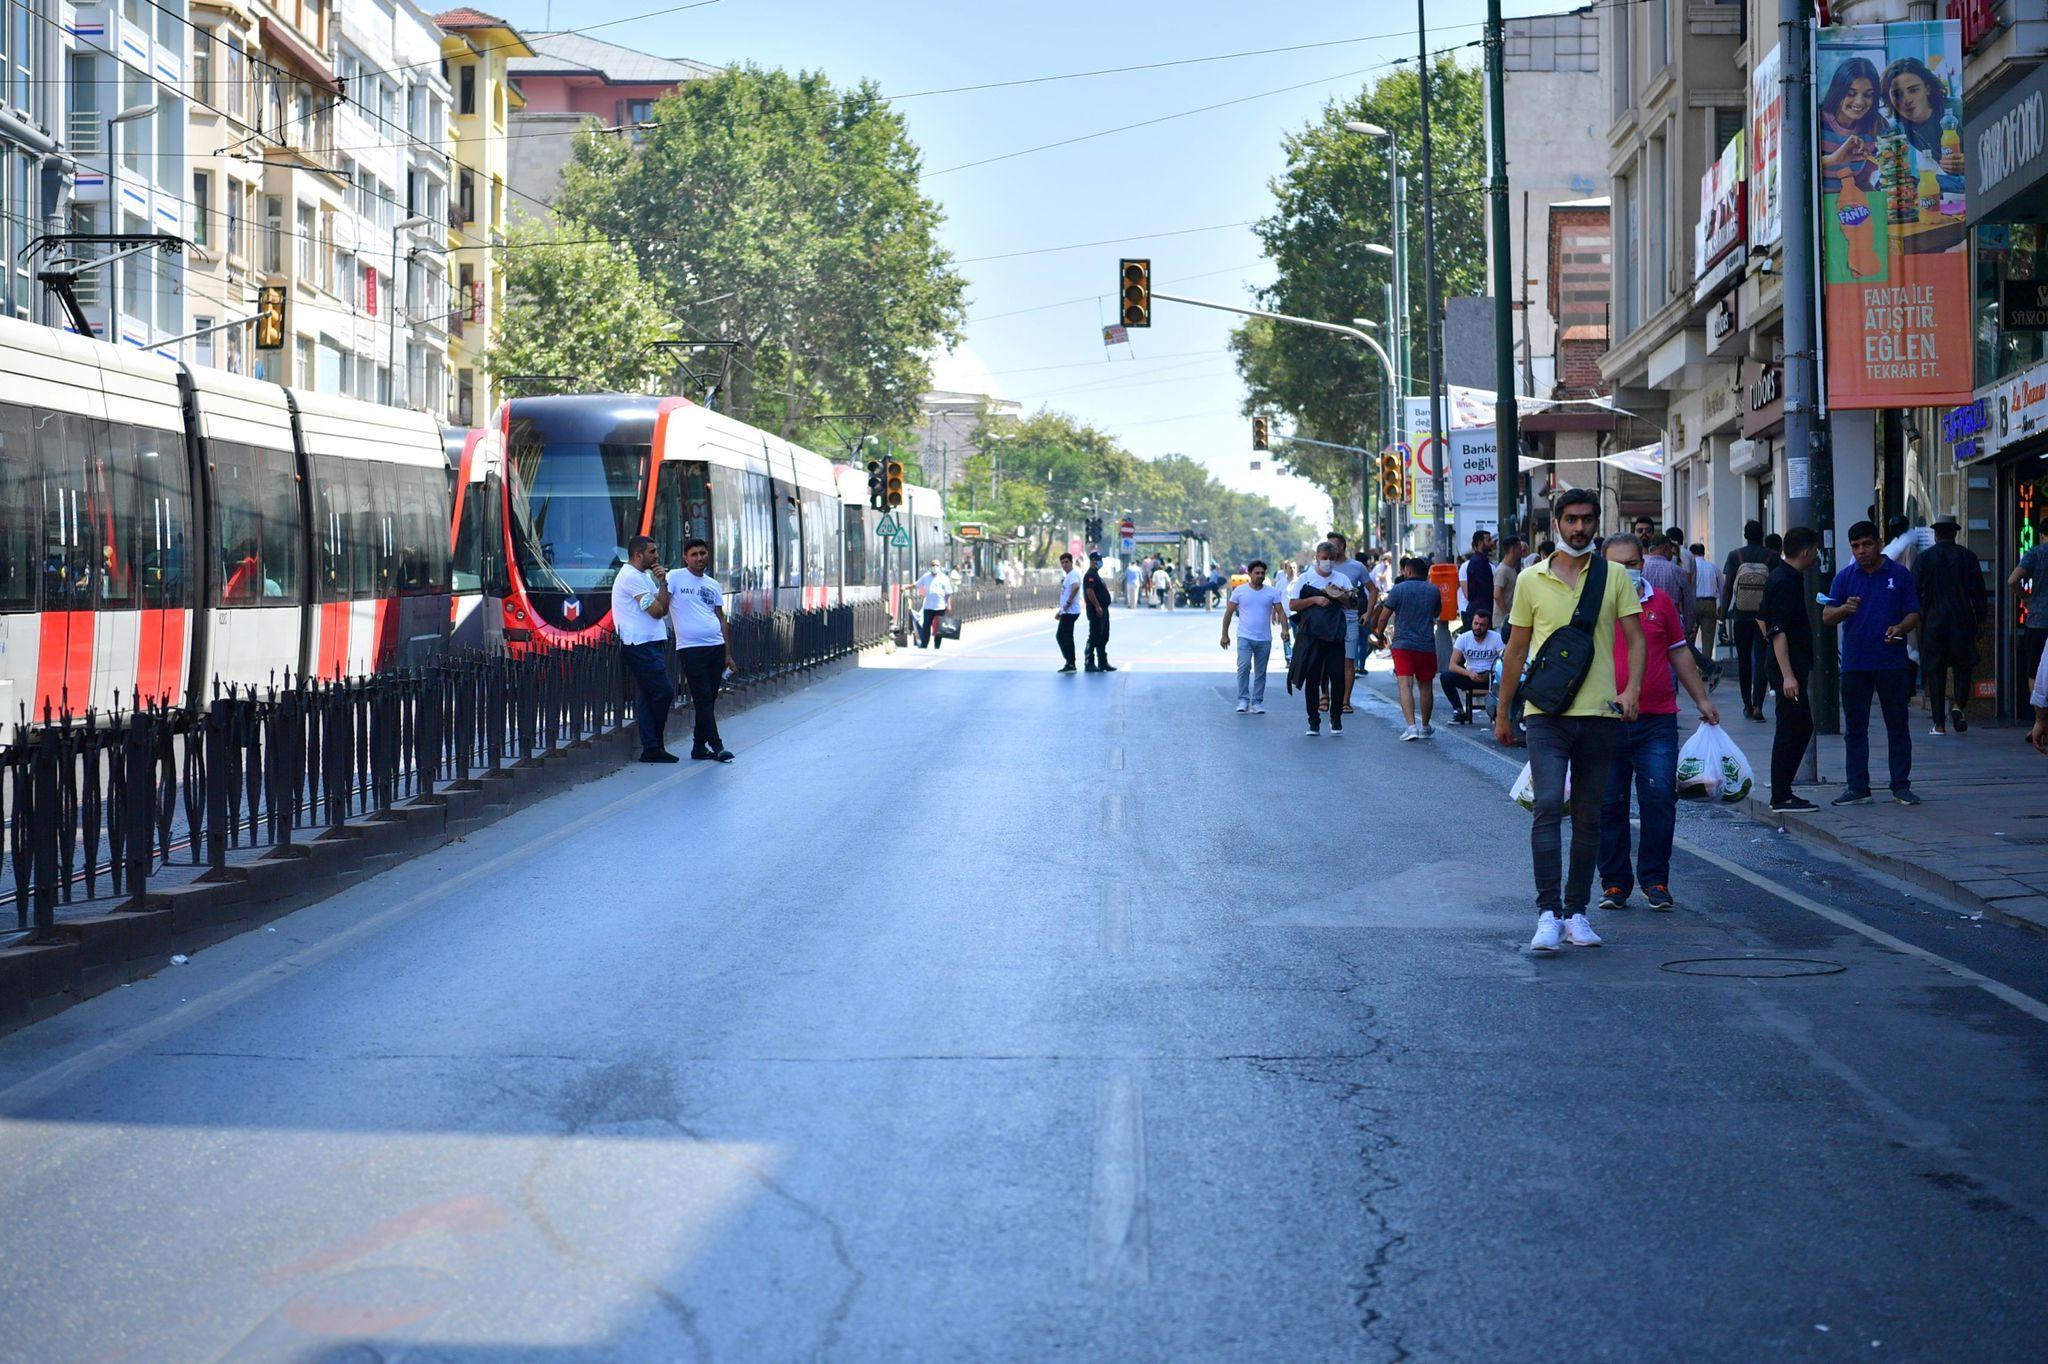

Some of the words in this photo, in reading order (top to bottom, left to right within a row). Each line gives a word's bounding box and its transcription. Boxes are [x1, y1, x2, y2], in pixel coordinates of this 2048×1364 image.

[1838, 205, 1870, 223] FANTA
[1864, 287, 1909, 306] FANTA
[1912, 283, 1935, 304] İLE
[1864, 306, 1939, 333] ATIŞTIR.
[1865, 330, 1940, 362] EĞLEN.
[1865, 363, 1918, 380] TEKRAR
[1921, 362, 1940, 378] ET.
[1463, 443, 1497, 454] Banka
[1464, 457, 1494, 470] değil,
[1465, 473, 1497, 486] papar
